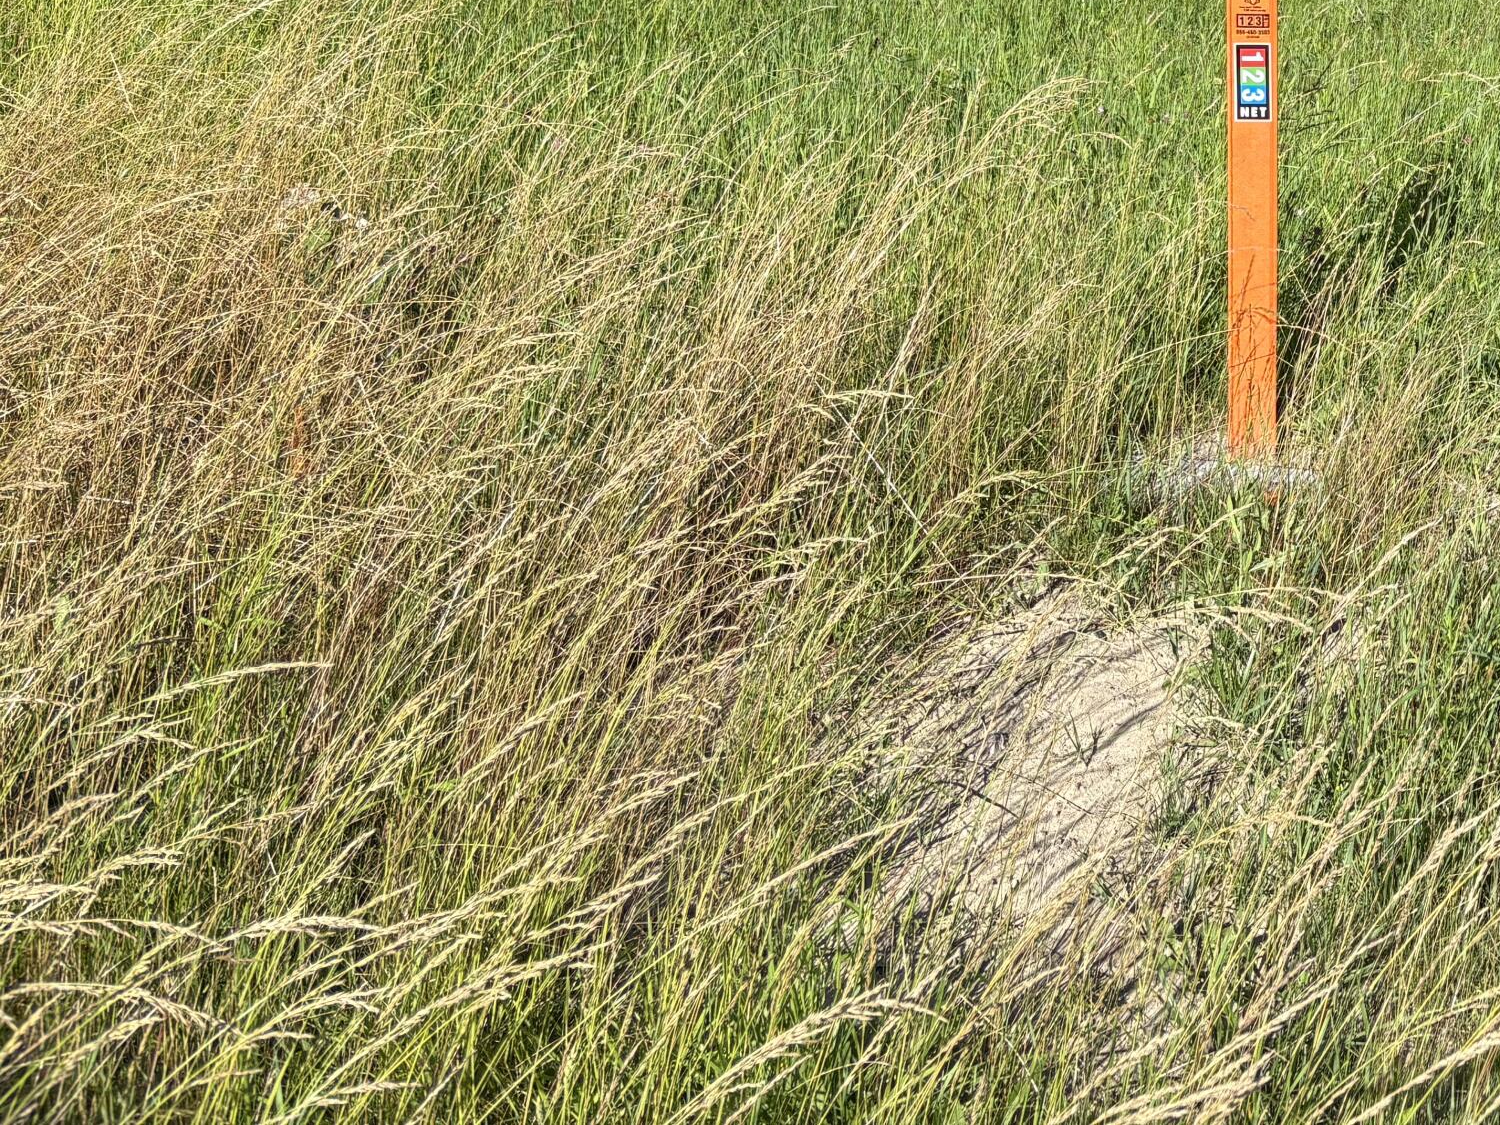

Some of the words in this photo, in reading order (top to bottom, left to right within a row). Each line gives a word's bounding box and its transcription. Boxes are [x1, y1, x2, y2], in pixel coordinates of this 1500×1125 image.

[1239, 16, 1262, 26] 123
[1241, 51, 1265, 102] 123
[1240, 106, 1267, 118] NET
